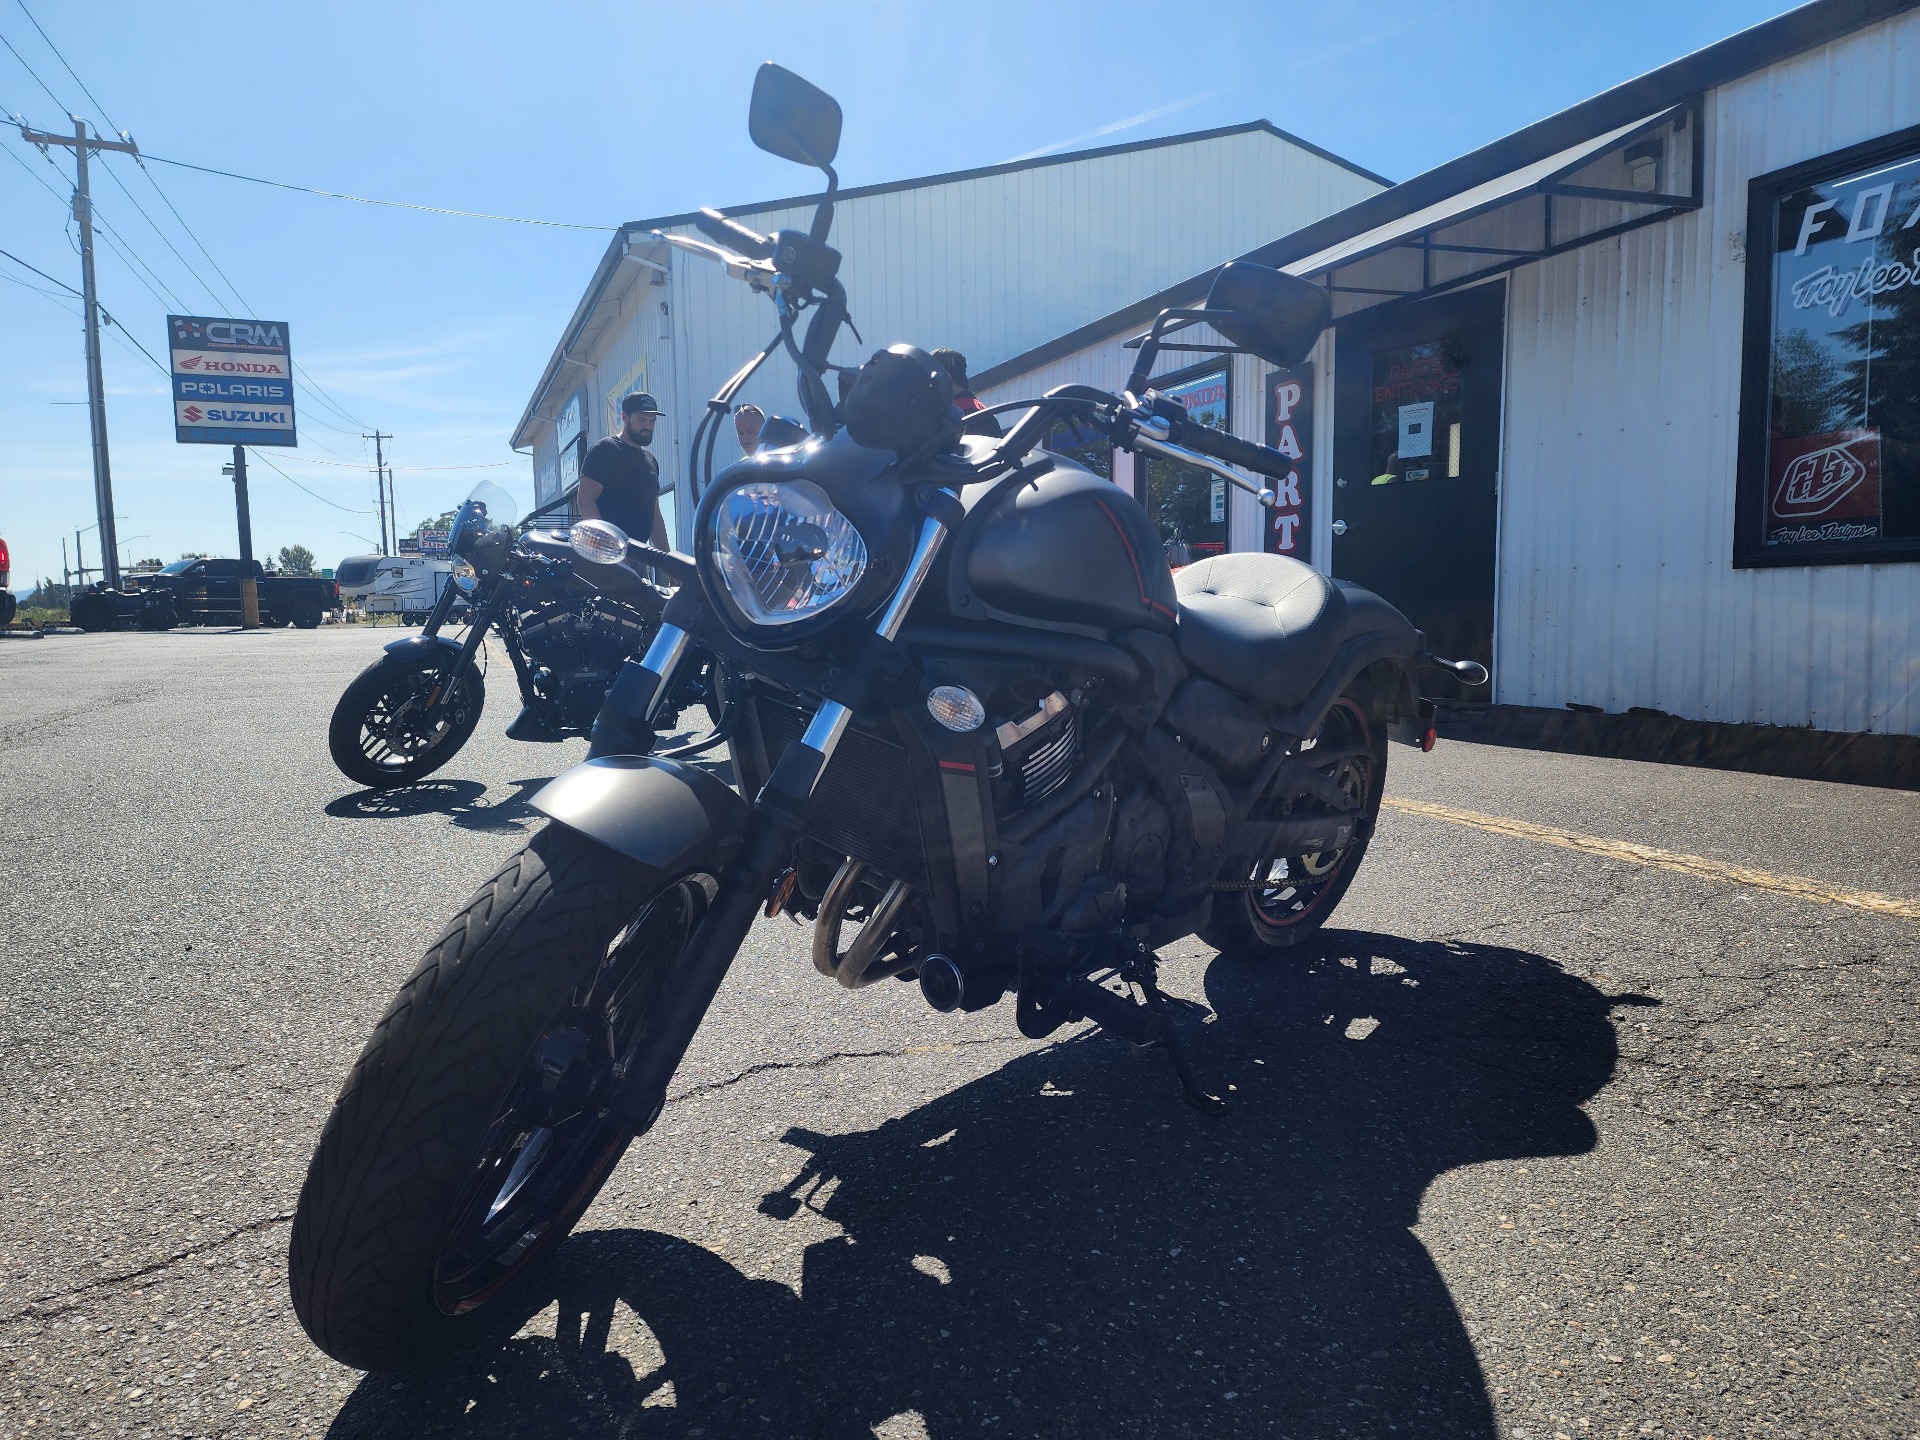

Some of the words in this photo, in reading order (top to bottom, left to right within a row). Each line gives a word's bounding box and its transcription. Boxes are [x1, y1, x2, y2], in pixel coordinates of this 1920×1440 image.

[1850, 257, 1912, 299] Lee
[206, 322, 284, 347] CRM
[203, 361, 283, 374] HONDA
[181, 382, 285, 398] POLARIS
[1375, 373, 1459, 403] ENTRANCE
[207, 409, 286, 423] SUZUKI
[1274, 383, 1303, 550] PART
[1797, 525, 1821, 542] Lee
[1820, 522, 1878, 541] Designs
